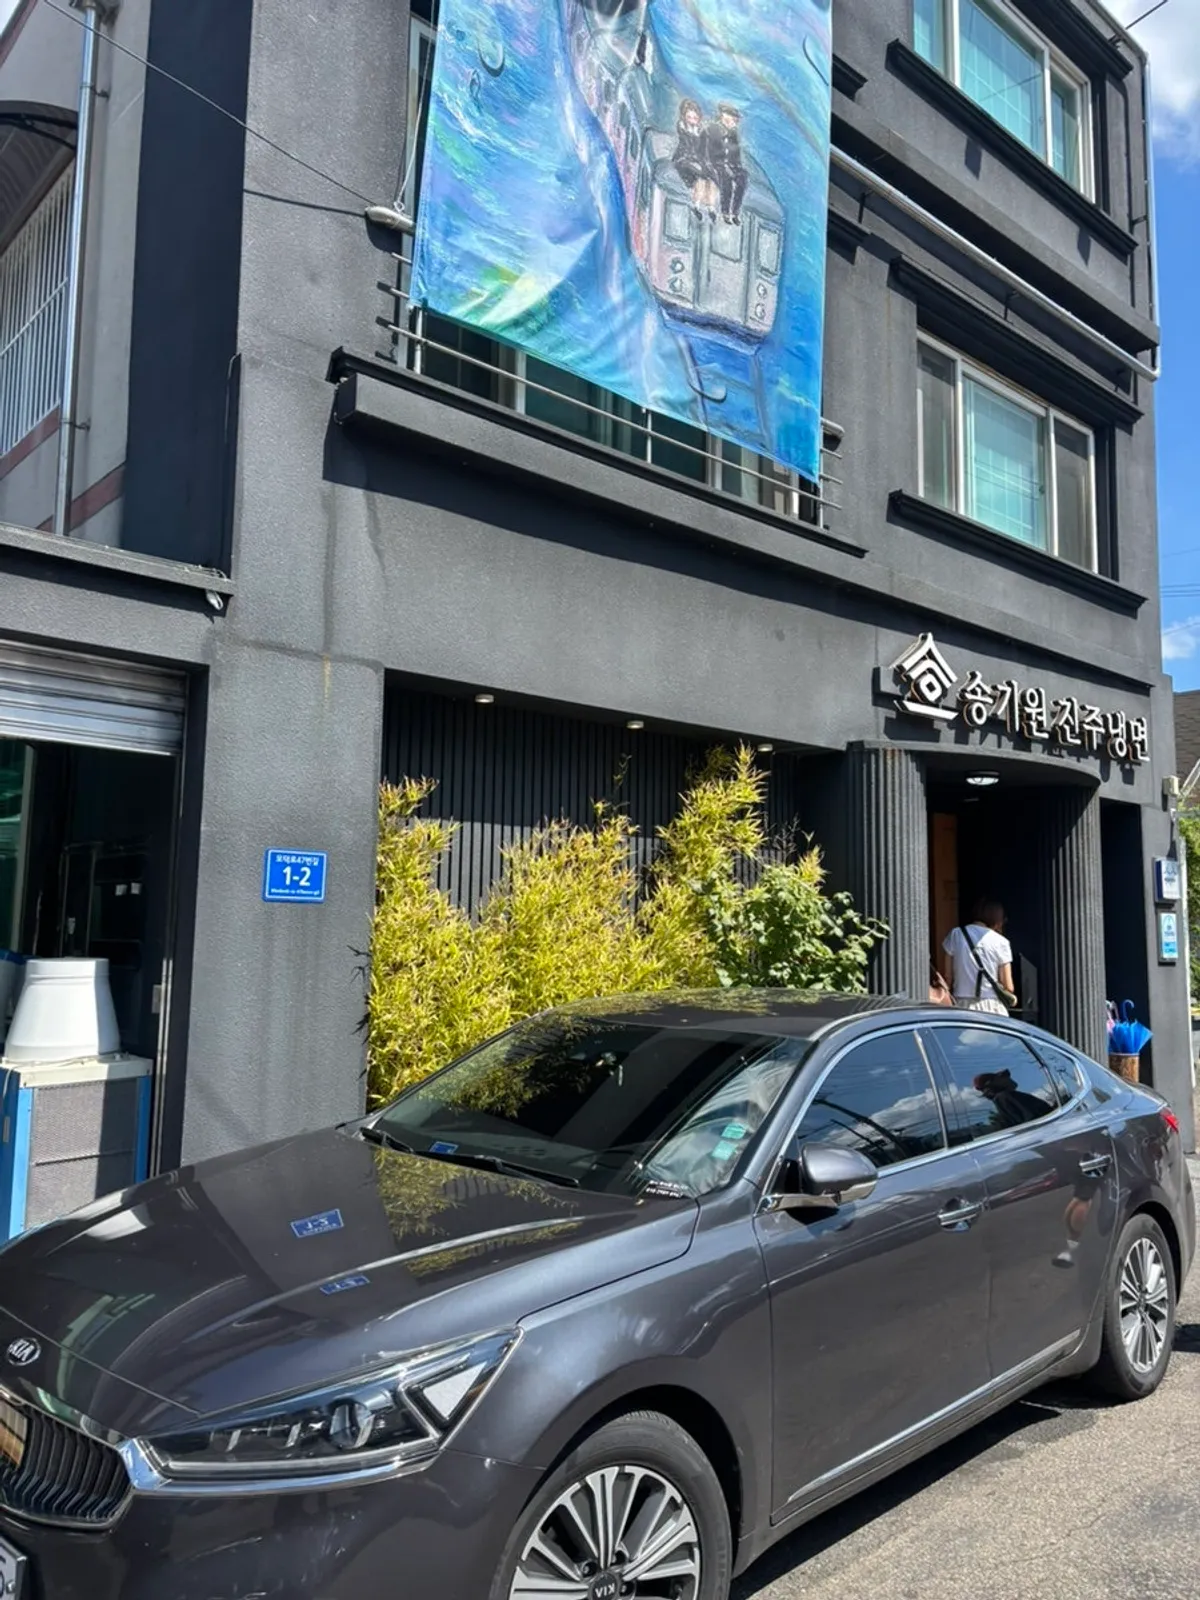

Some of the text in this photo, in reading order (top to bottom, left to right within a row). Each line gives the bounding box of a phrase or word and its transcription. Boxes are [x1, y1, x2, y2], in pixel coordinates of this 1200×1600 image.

[961, 670, 1150, 762] 송기원 진주냉면
[282, 865, 311, 887] 1-2
[8, 1339, 35, 1362] KIA
